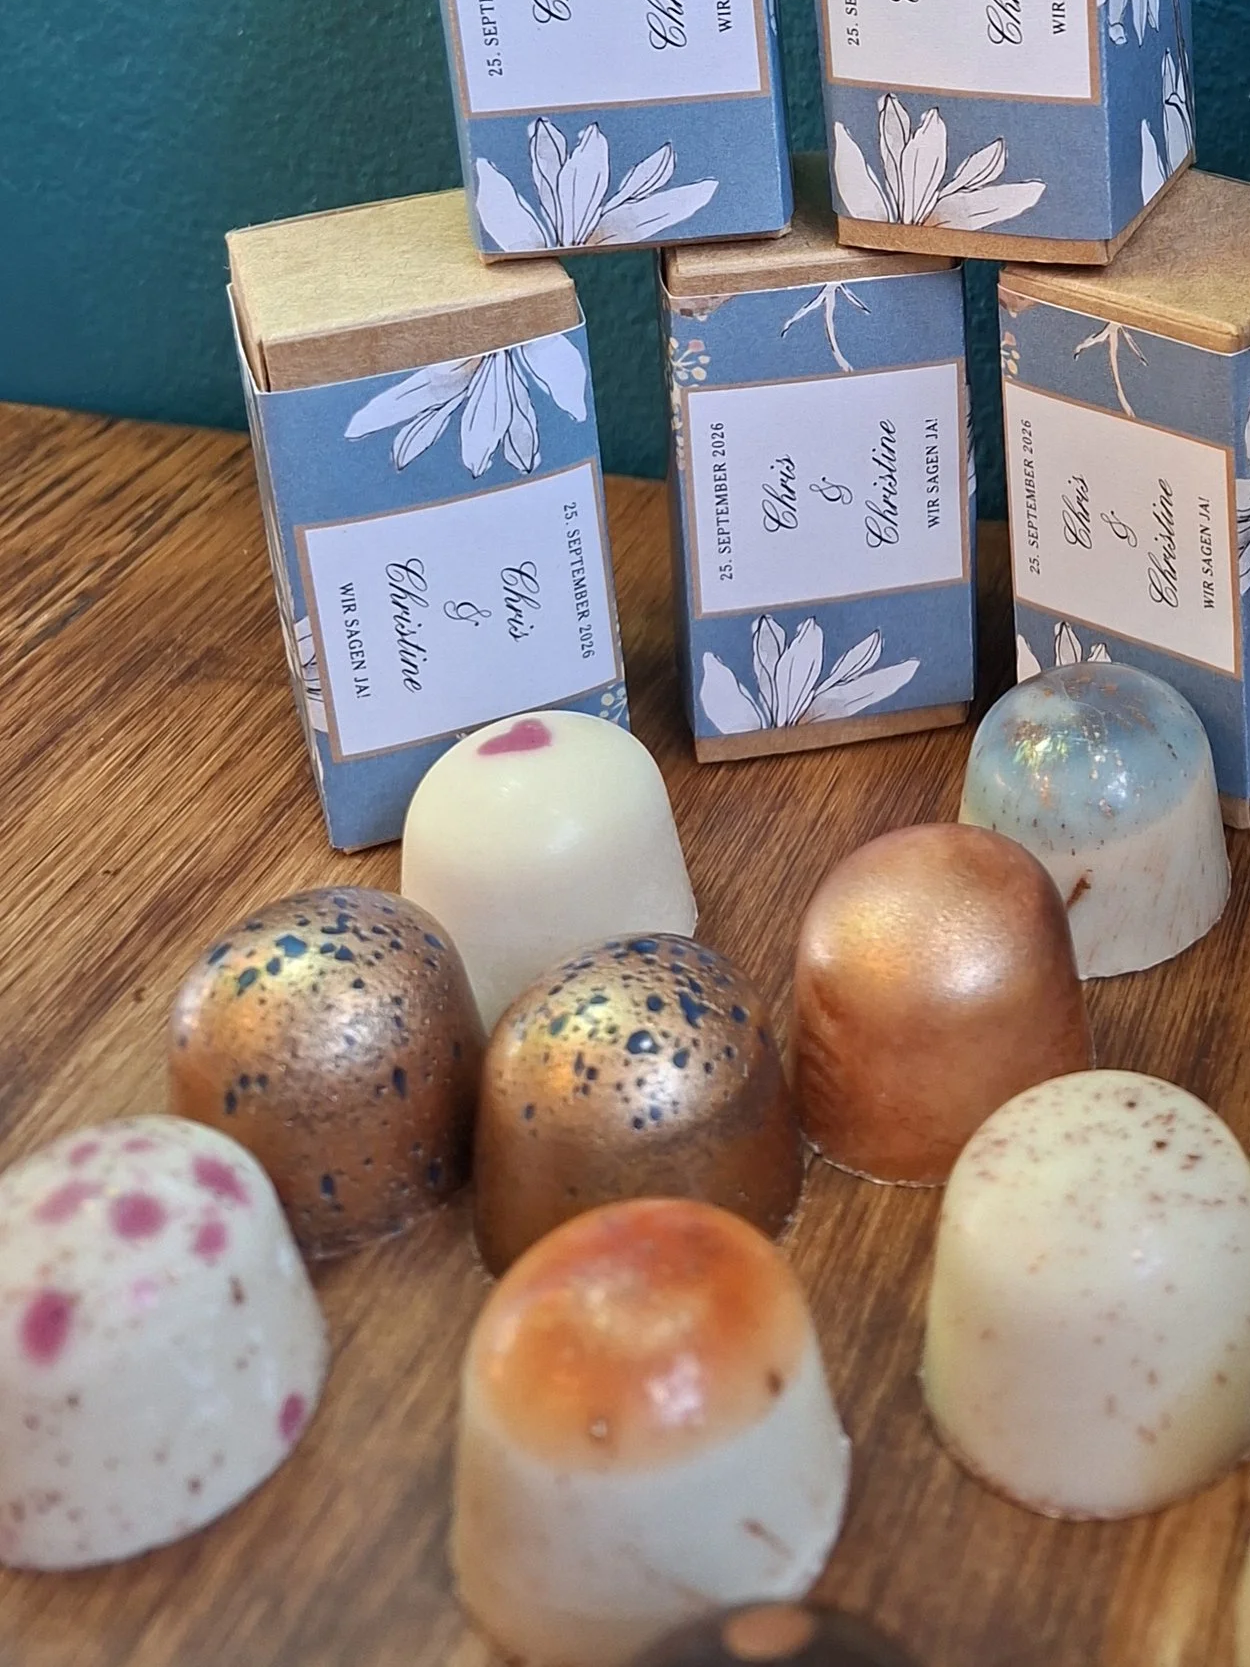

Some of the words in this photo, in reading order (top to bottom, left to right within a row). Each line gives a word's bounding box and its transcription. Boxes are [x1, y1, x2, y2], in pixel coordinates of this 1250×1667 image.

[845, 22, 861, 47] 25.
[1051, 1, 1067, 35] WIR
[485, 51, 504, 77] 25.
[709, 422, 726, 458] 2026
[924, 418, 939, 440] JA!
[1020, 418, 1034, 455] 2026
[864, 418, 900, 549] Christine
[924, 444, 940, 494] SAGEN
[712, 461, 732, 555] SEPTEMBER
[761, 453, 799, 533] Chris
[808, 476, 854, 506] &
[1023, 458, 1040, 550] SEPTEMBER
[1197, 496, 1211, 522] JA!
[563, 501, 580, 527] 25.
[926, 497, 941, 529] WIR
[1061, 473, 1093, 550] Chris
[1099, 510, 1138, 548] &
[1147, 478, 1179, 609] Christine
[1199, 523, 1214, 578] SAGEN
[566, 528, 591, 622] SEPTEMBER
[718, 558, 734, 582] 25.
[1028, 551, 1042, 576] 25.
[338, 581, 357, 615] WIR
[500, 560, 542, 643] Chris
[1202, 580, 1216, 609] WIR
[384, 557, 430, 694] Christine
[442, 600, 493, 627] &
[344, 618, 367, 671] SAGEN
[578, 623, 596, 659] 2026
[353, 676, 372, 699] JA!
